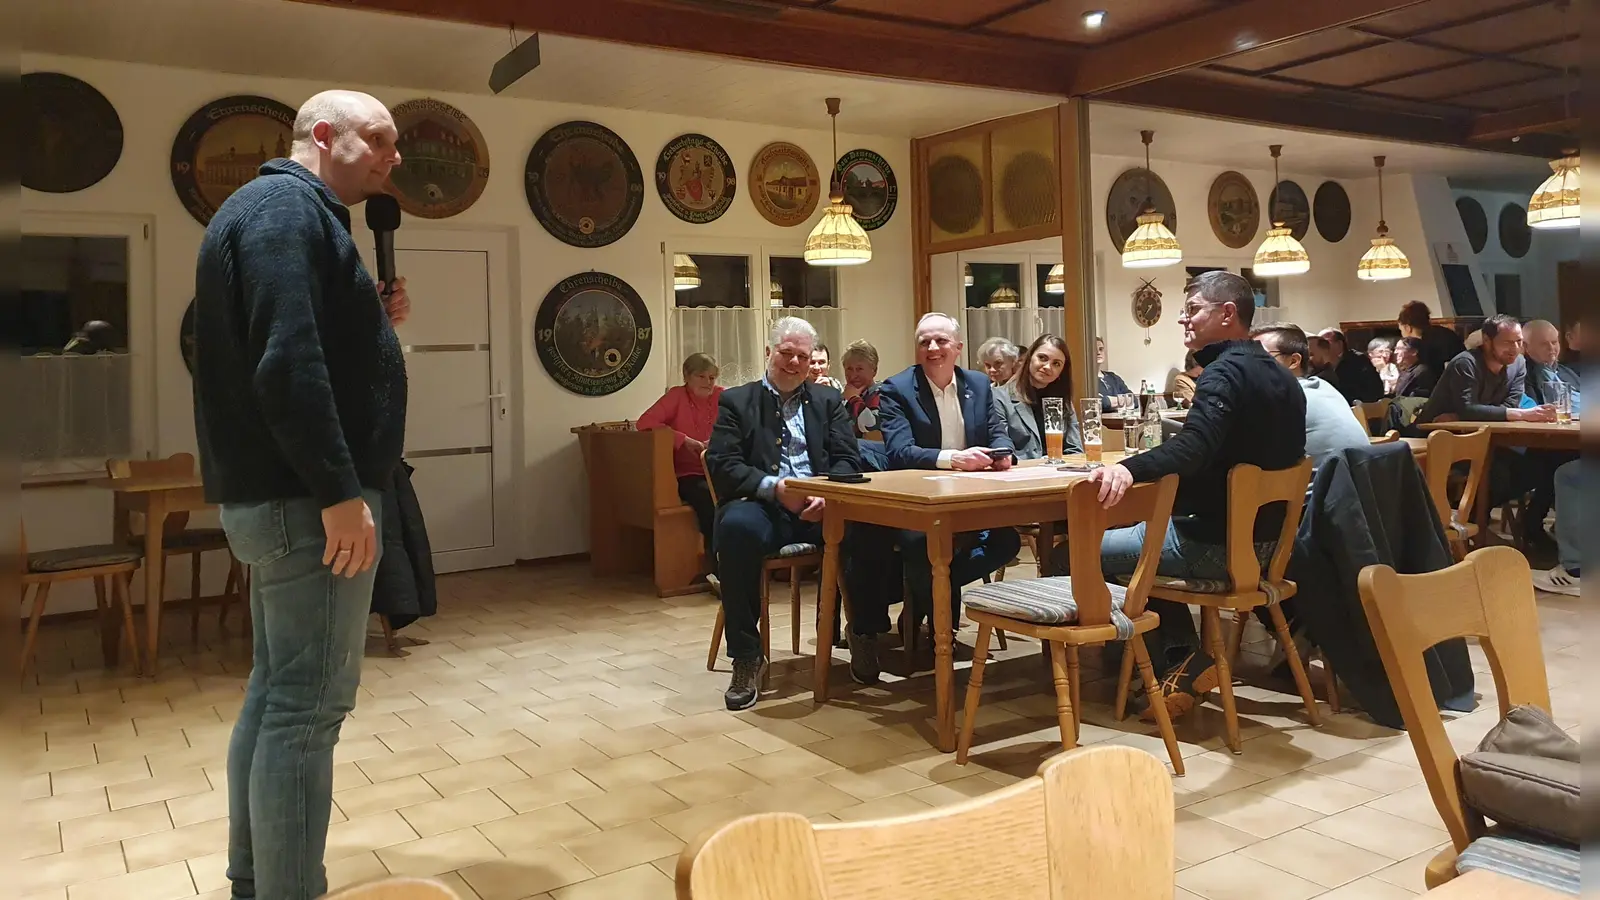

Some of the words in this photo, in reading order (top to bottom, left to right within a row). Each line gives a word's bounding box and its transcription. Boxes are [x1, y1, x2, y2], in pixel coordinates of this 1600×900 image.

[726, 177, 735, 187] 98
[559, 274, 622, 294] Ehrenscheibe
[537, 328, 552, 342] 19
[637, 327, 651, 340] 87
